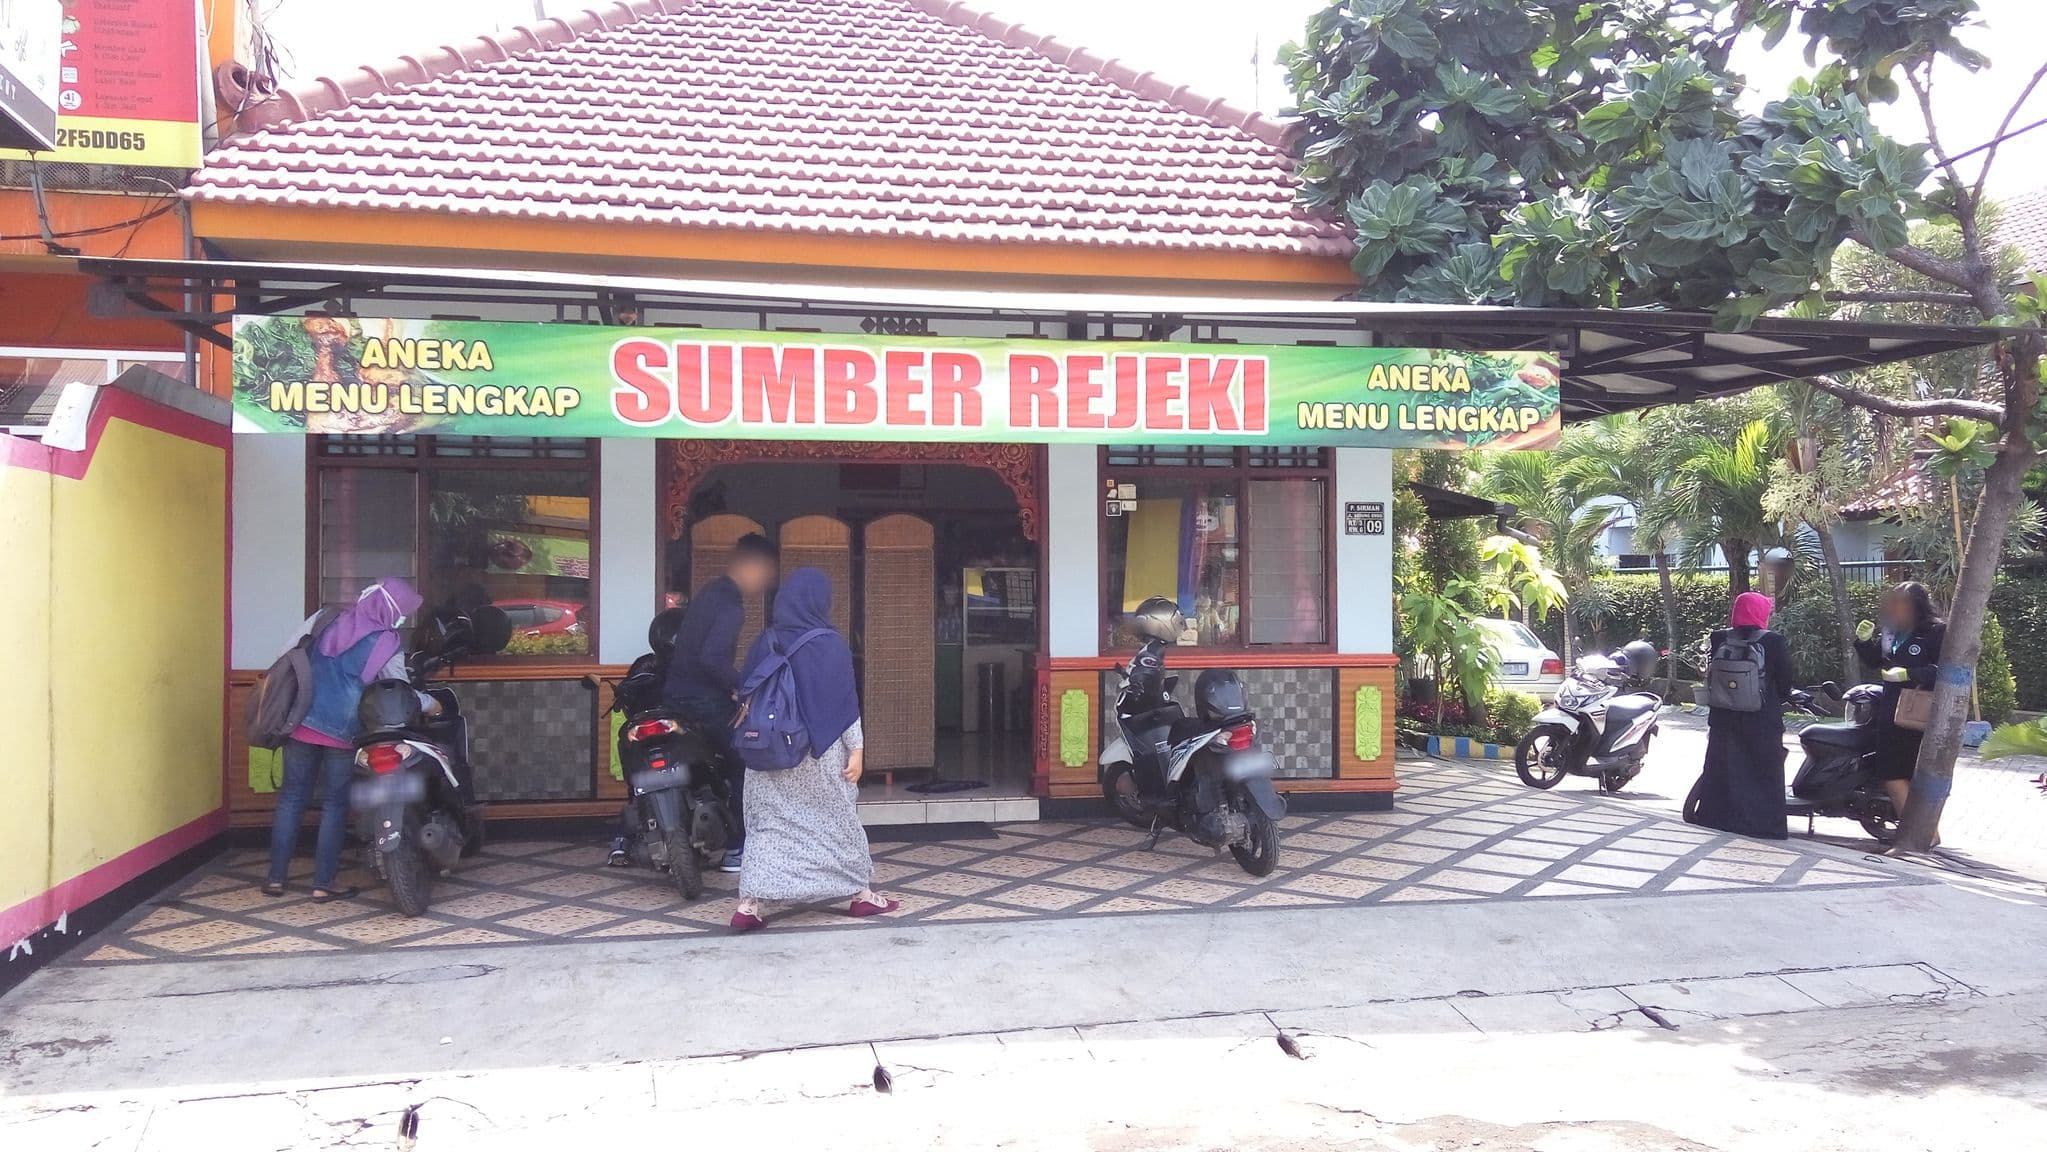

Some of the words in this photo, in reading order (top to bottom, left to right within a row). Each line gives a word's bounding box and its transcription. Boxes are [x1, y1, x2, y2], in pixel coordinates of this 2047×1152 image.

[360, 337, 493, 371] ANEKA
[613, 341, 984, 427] SUMBER
[1008, 352, 1267, 432] REJEKI
[1367, 363, 1472, 393] ANEKA
[269, 380, 388, 414] MENU
[399, 384, 581, 417] LENGKAP
[1297, 402, 1390, 430] MENU
[1398, 403, 1541, 433] LENGKAP
[1367, 520, 1382, 533] 09
